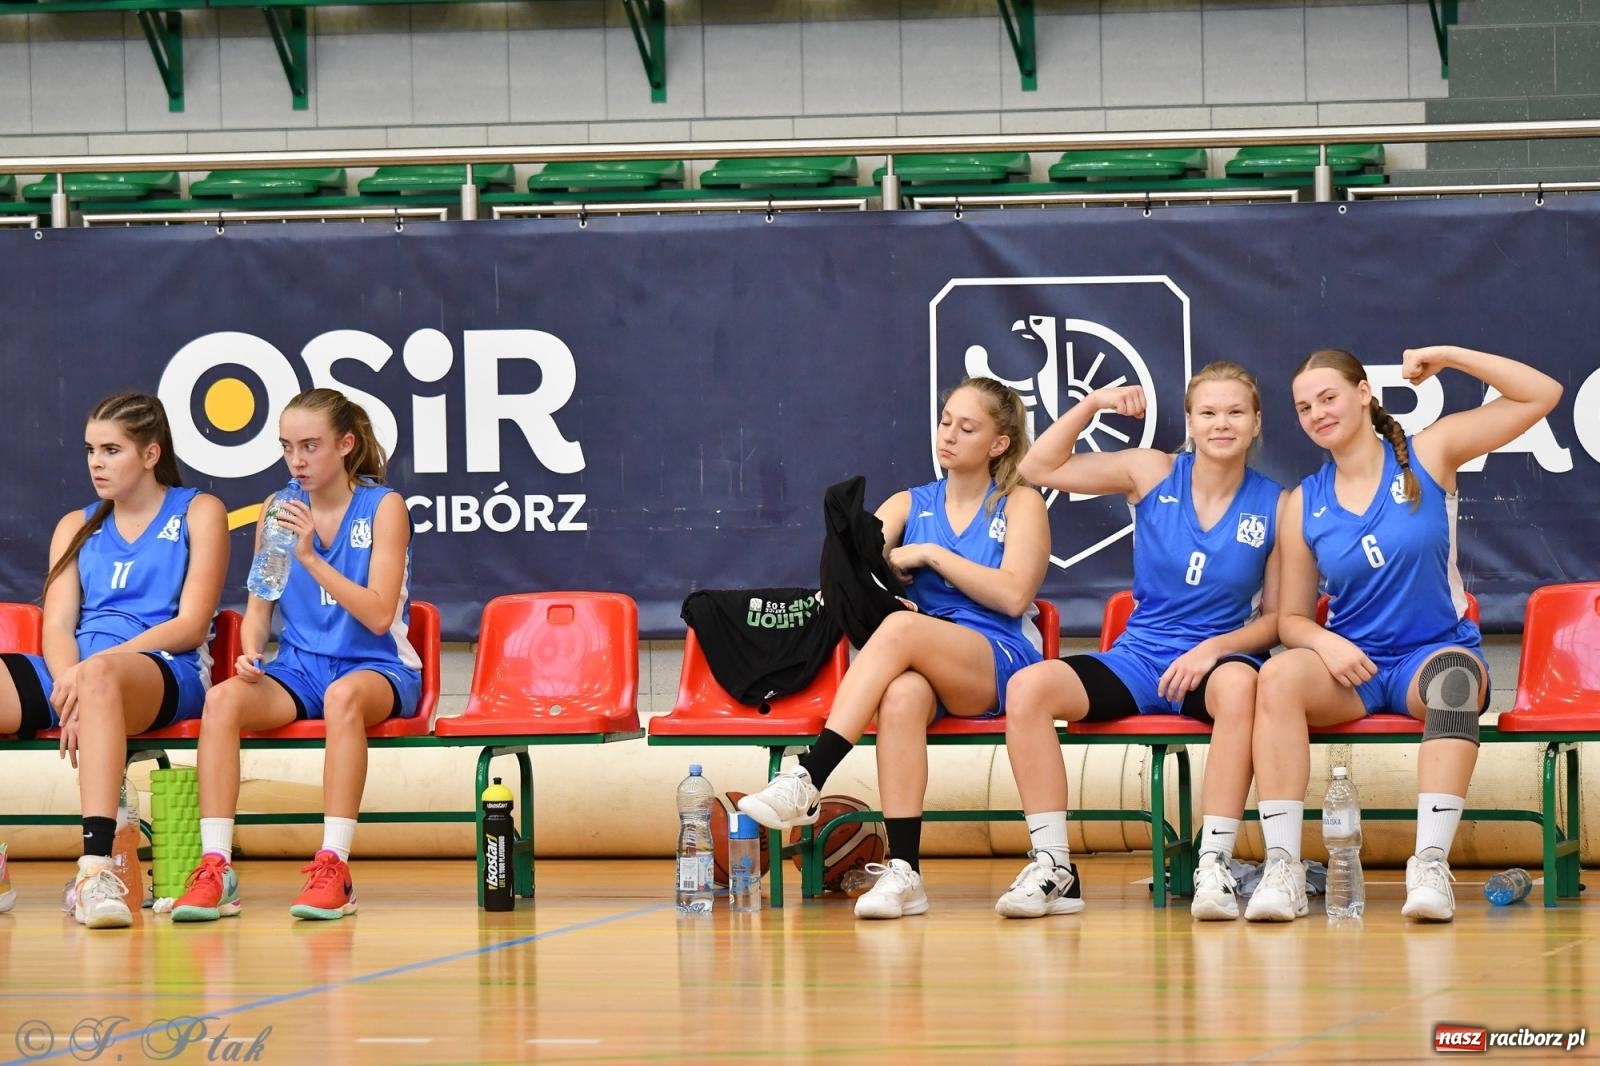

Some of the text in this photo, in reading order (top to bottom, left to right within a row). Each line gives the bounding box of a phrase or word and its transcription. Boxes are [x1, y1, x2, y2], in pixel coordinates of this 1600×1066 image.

[407, 481, 588, 533] CIBÓRZ
[1185, 551, 1207, 586] 8
[1361, 534, 1386, 569] 6
[111, 560, 135, 590] 11
[486, 835, 499, 889] isostar
